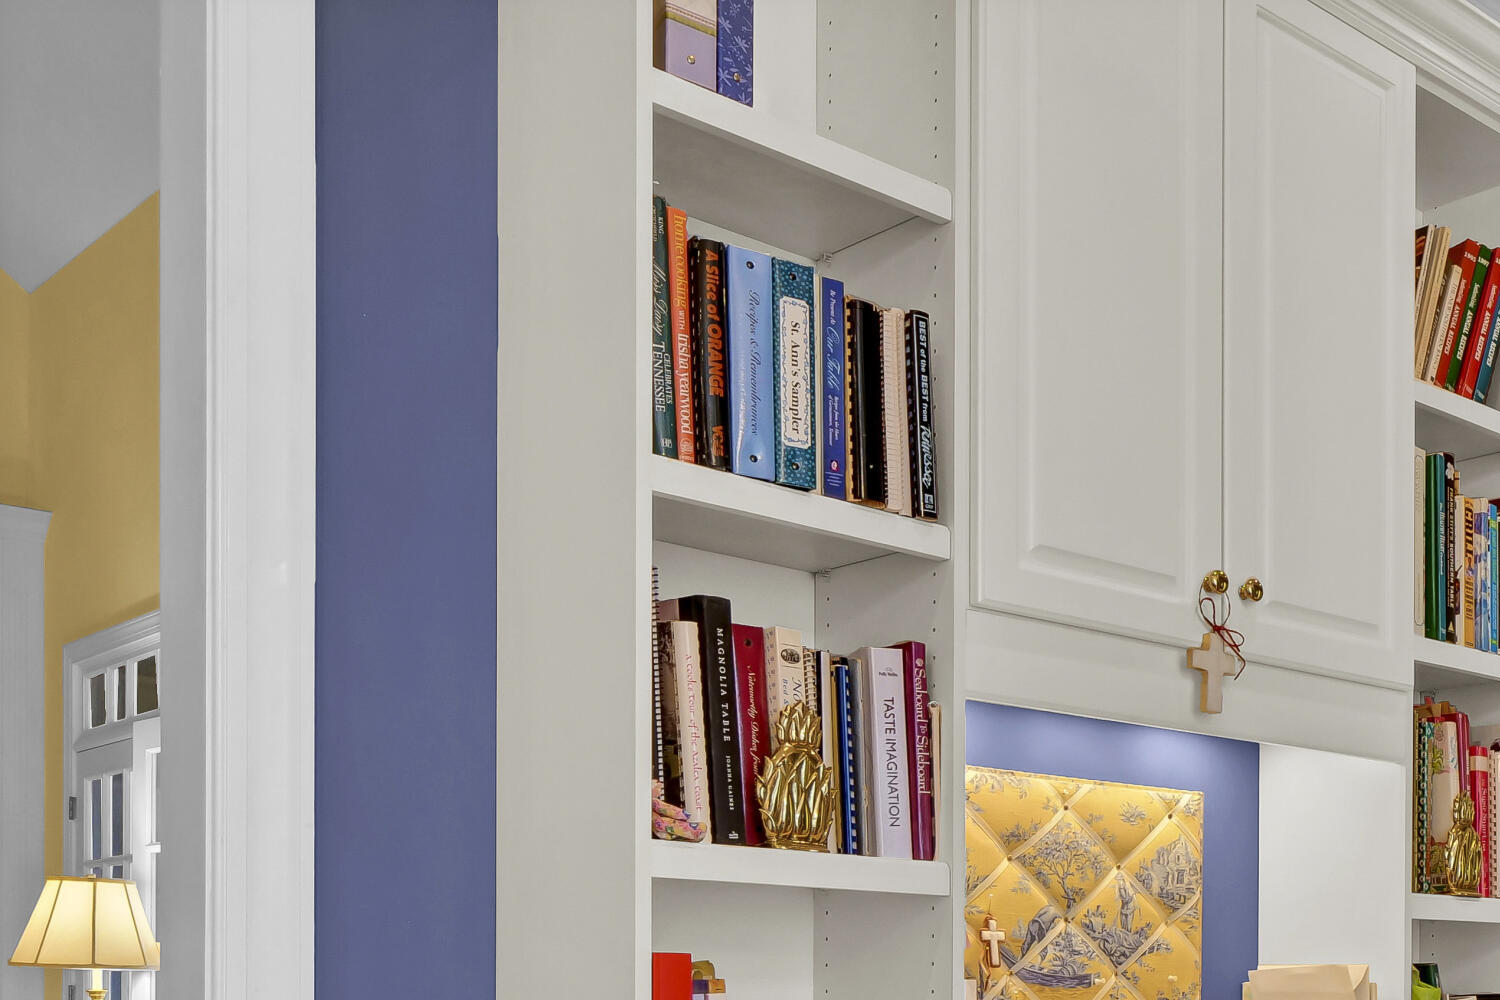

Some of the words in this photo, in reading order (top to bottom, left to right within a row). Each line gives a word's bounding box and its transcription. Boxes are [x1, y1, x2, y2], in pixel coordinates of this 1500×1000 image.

[674, 214, 686, 254] home
[706, 249, 718, 260] A
[674, 256, 688, 310] cooking
[706, 264, 719, 296] Slice
[707, 304, 720, 321] of
[745, 290, 761, 335] Recipes
[791, 320, 801, 335] St.
[678, 333, 690, 368] trisha
[919, 320, 927, 347] BEST
[920, 349, 926, 358] of
[652, 341, 666, 413] TENNESSEE
[708, 324, 724, 397] ORANGE
[791, 340, 801, 377] Ann's
[826, 353, 840, 390] Table
[920, 359, 928, 372] the
[664, 353, 673, 405] CELEBRATES
[750, 350, 761, 436] Remembrances
[921, 374, 929, 401] BEST
[676, 370, 693, 434] yearwood
[789, 381, 802, 434] Sampler
[920, 425, 933, 489] Tennessee
[716, 627, 727, 697] MAGNOLIA
[747, 665, 759, 719] Noteworthy
[914, 668, 928, 722] Seaboard
[721, 702, 731, 742] TABLE
[883, 696, 896, 735] TASTE
[750, 721, 760, 751] Dishes
[885, 738, 900, 828] IMAGINATION
[916, 735, 931, 795] Sideboard
